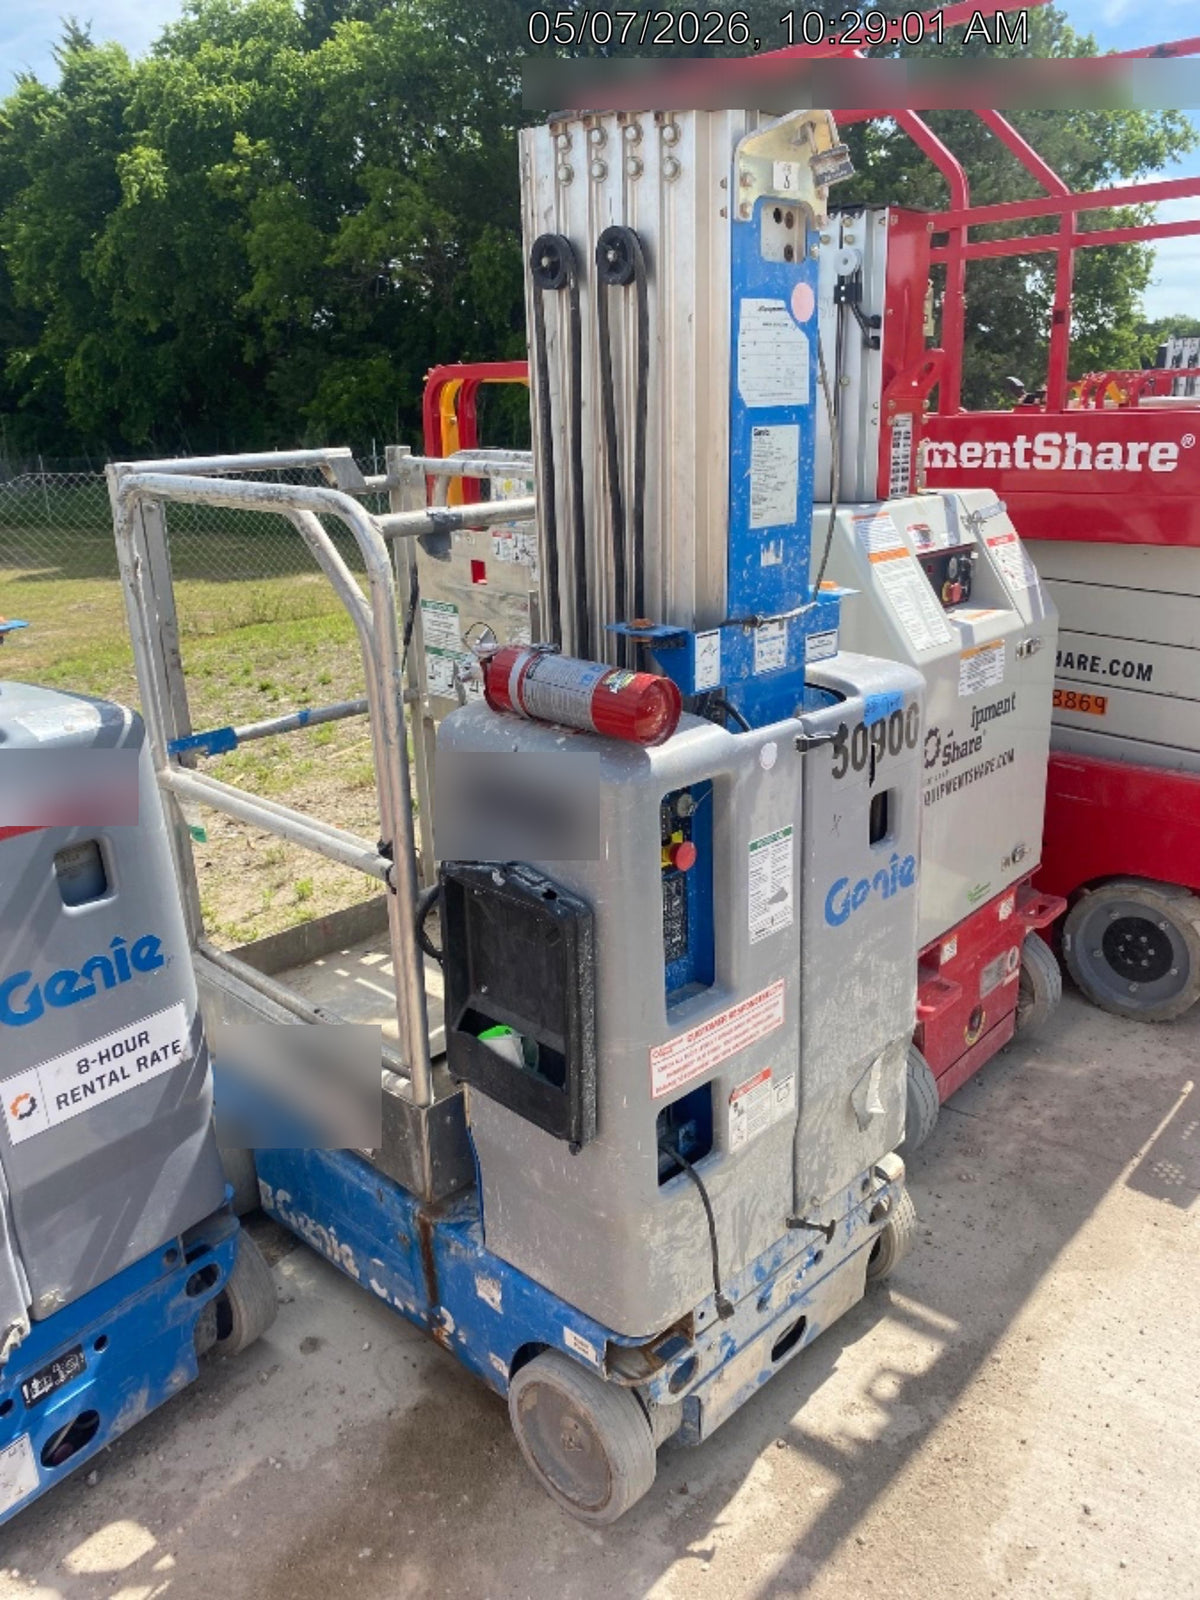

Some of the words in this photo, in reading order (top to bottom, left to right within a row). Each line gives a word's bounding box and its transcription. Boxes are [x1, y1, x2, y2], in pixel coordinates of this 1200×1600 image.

[55, 1065, 130, 1111] RENTAL
[135, 1038, 182, 1073] RATE
[75, 1030, 151, 1076] 8-HOUR
